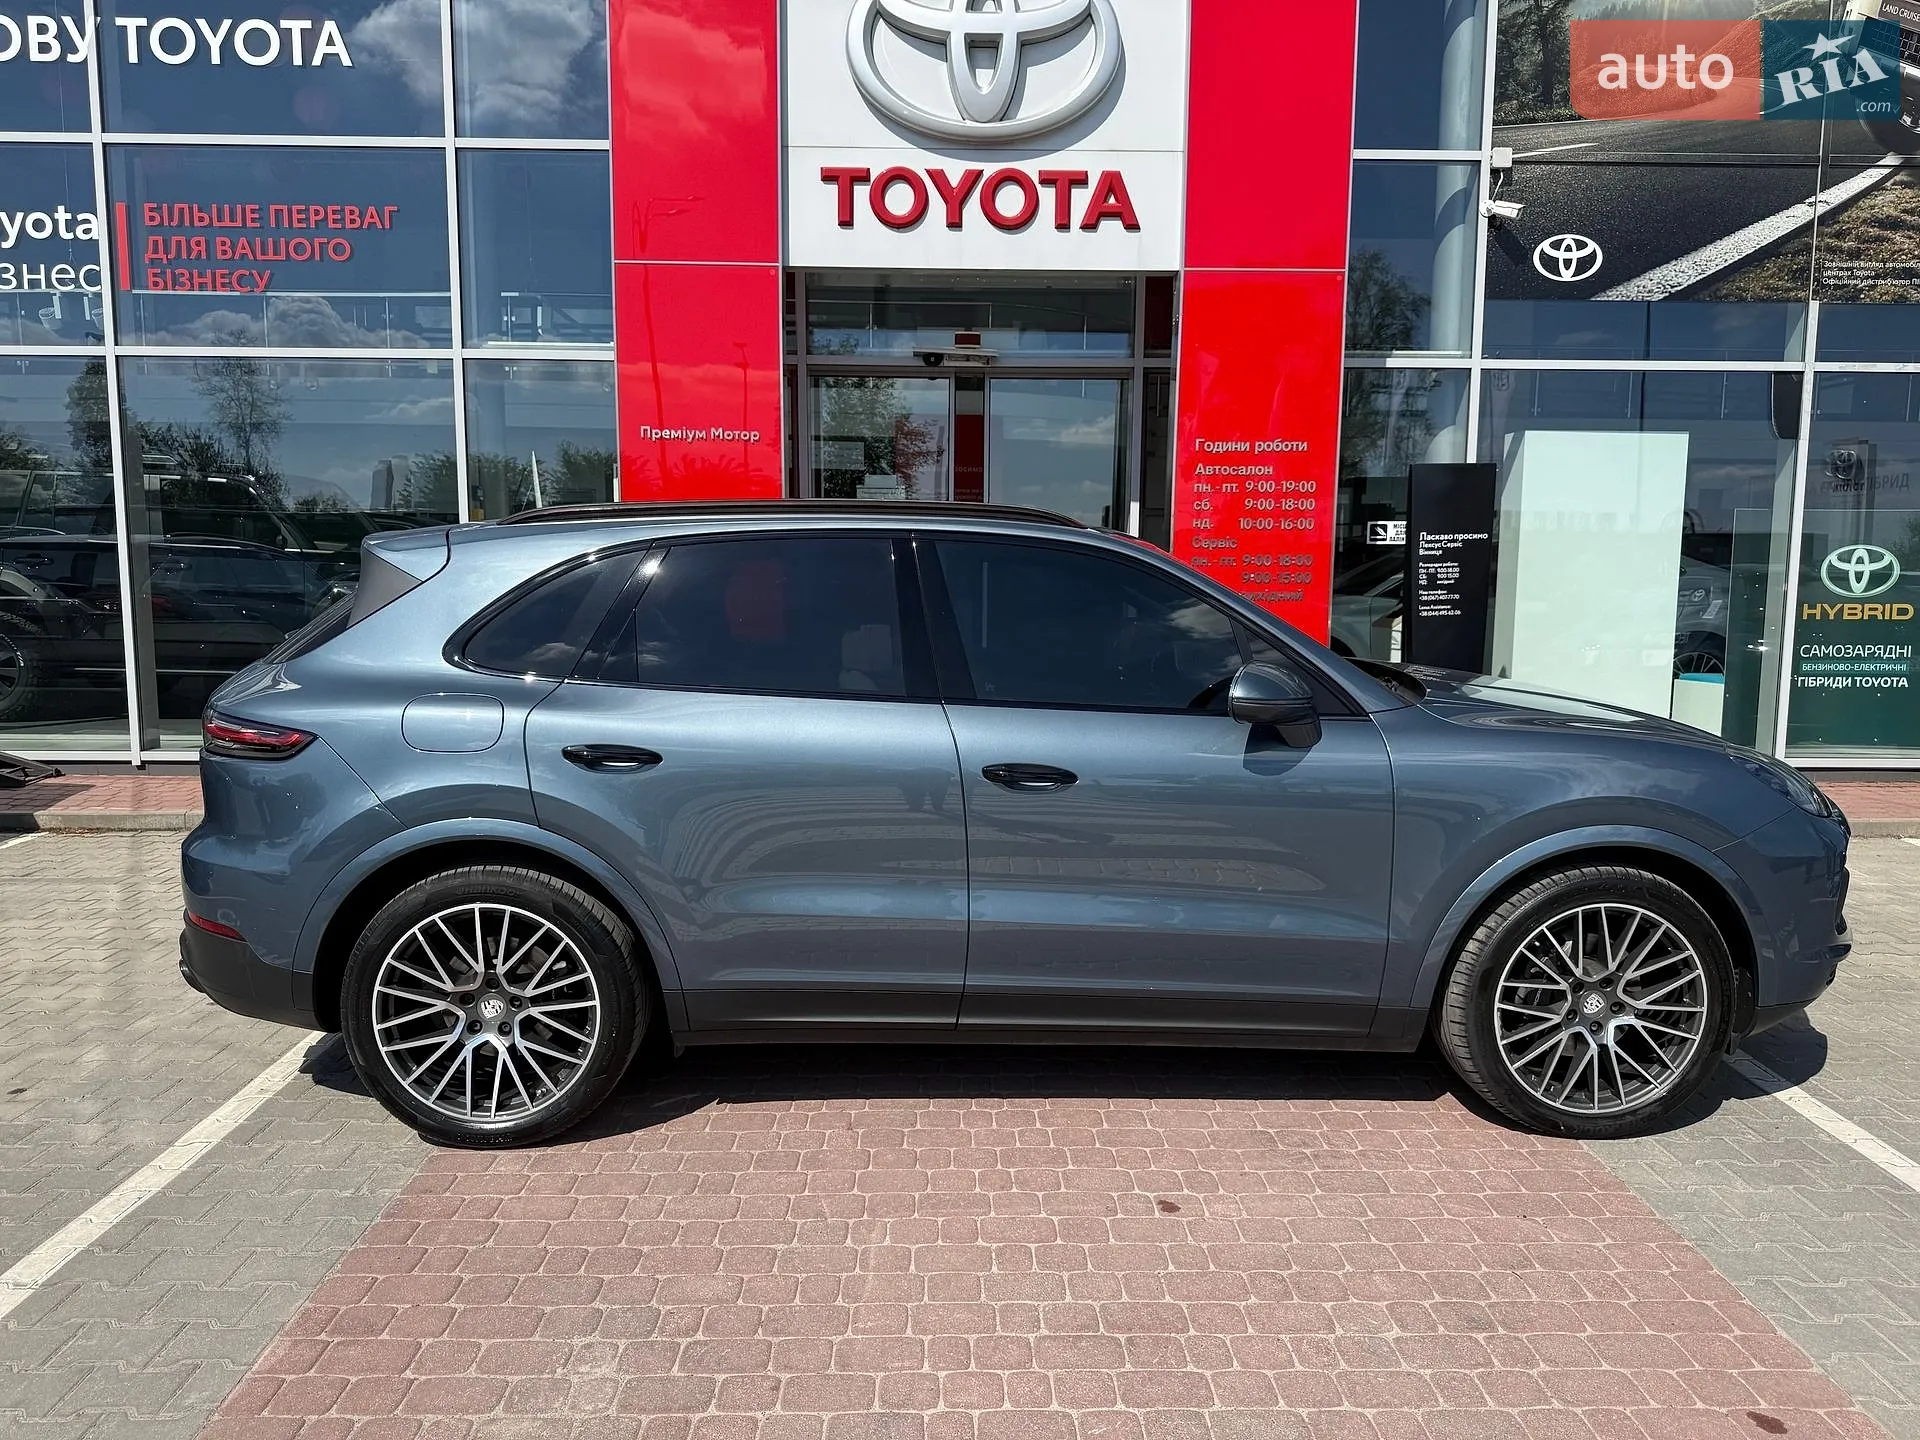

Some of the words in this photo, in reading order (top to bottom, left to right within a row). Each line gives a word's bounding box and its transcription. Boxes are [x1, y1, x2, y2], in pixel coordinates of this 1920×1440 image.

[1882, 3, 1899, 15] LAND
[115, 16, 352, 67] TOYOTA
[820, 166, 1141, 232] TOYOTA
[144, 202, 261, 228] БІЛЬШЕ
[269, 204, 398, 230] ПЕРЕВАГ
[144, 235, 207, 264] ДЛЯ
[215, 236, 352, 261] ВАШОГО
[1853, 269, 1875, 277] Toyota
[147, 268, 271, 294] БІЗНЕСУ
[640, 426, 706, 442] Преміум
[711, 427, 760, 442] Мотор
[1195, 438, 1250, 454] Години
[1254, 439, 1308, 454] роботи
[1195, 463, 1273, 475] Автосалон
[1245, 480, 1317, 493] 9:00-19:00
[1194, 500, 1213, 510] сб.
[1244, 498, 1316, 511] 9:00-18:00
[1192, 519, 1215, 529] нд.
[1239, 517, 1315, 530] 10:00-16:00
[1192, 536, 1238, 549] Сервіс
[1419, 532, 1453, 540] Ласкаво
[1454, 533, 1488, 541] просимо
[1243, 555, 1313, 567] 9:00-18:00
[1242, 572, 1312, 584] 9:00-15:00
[1802, 603, 1914, 620] HYBRID
[1800, 645, 1912, 659] САМОЗАРЯДНІ
[1802, 663, 1907, 672] БЕНЗИНОВО-ЕЛЕКТРИЧНІ
[1797, 677, 1852, 688] ГІБРИДИ
[1854, 677, 1909, 688] TOYOTA
